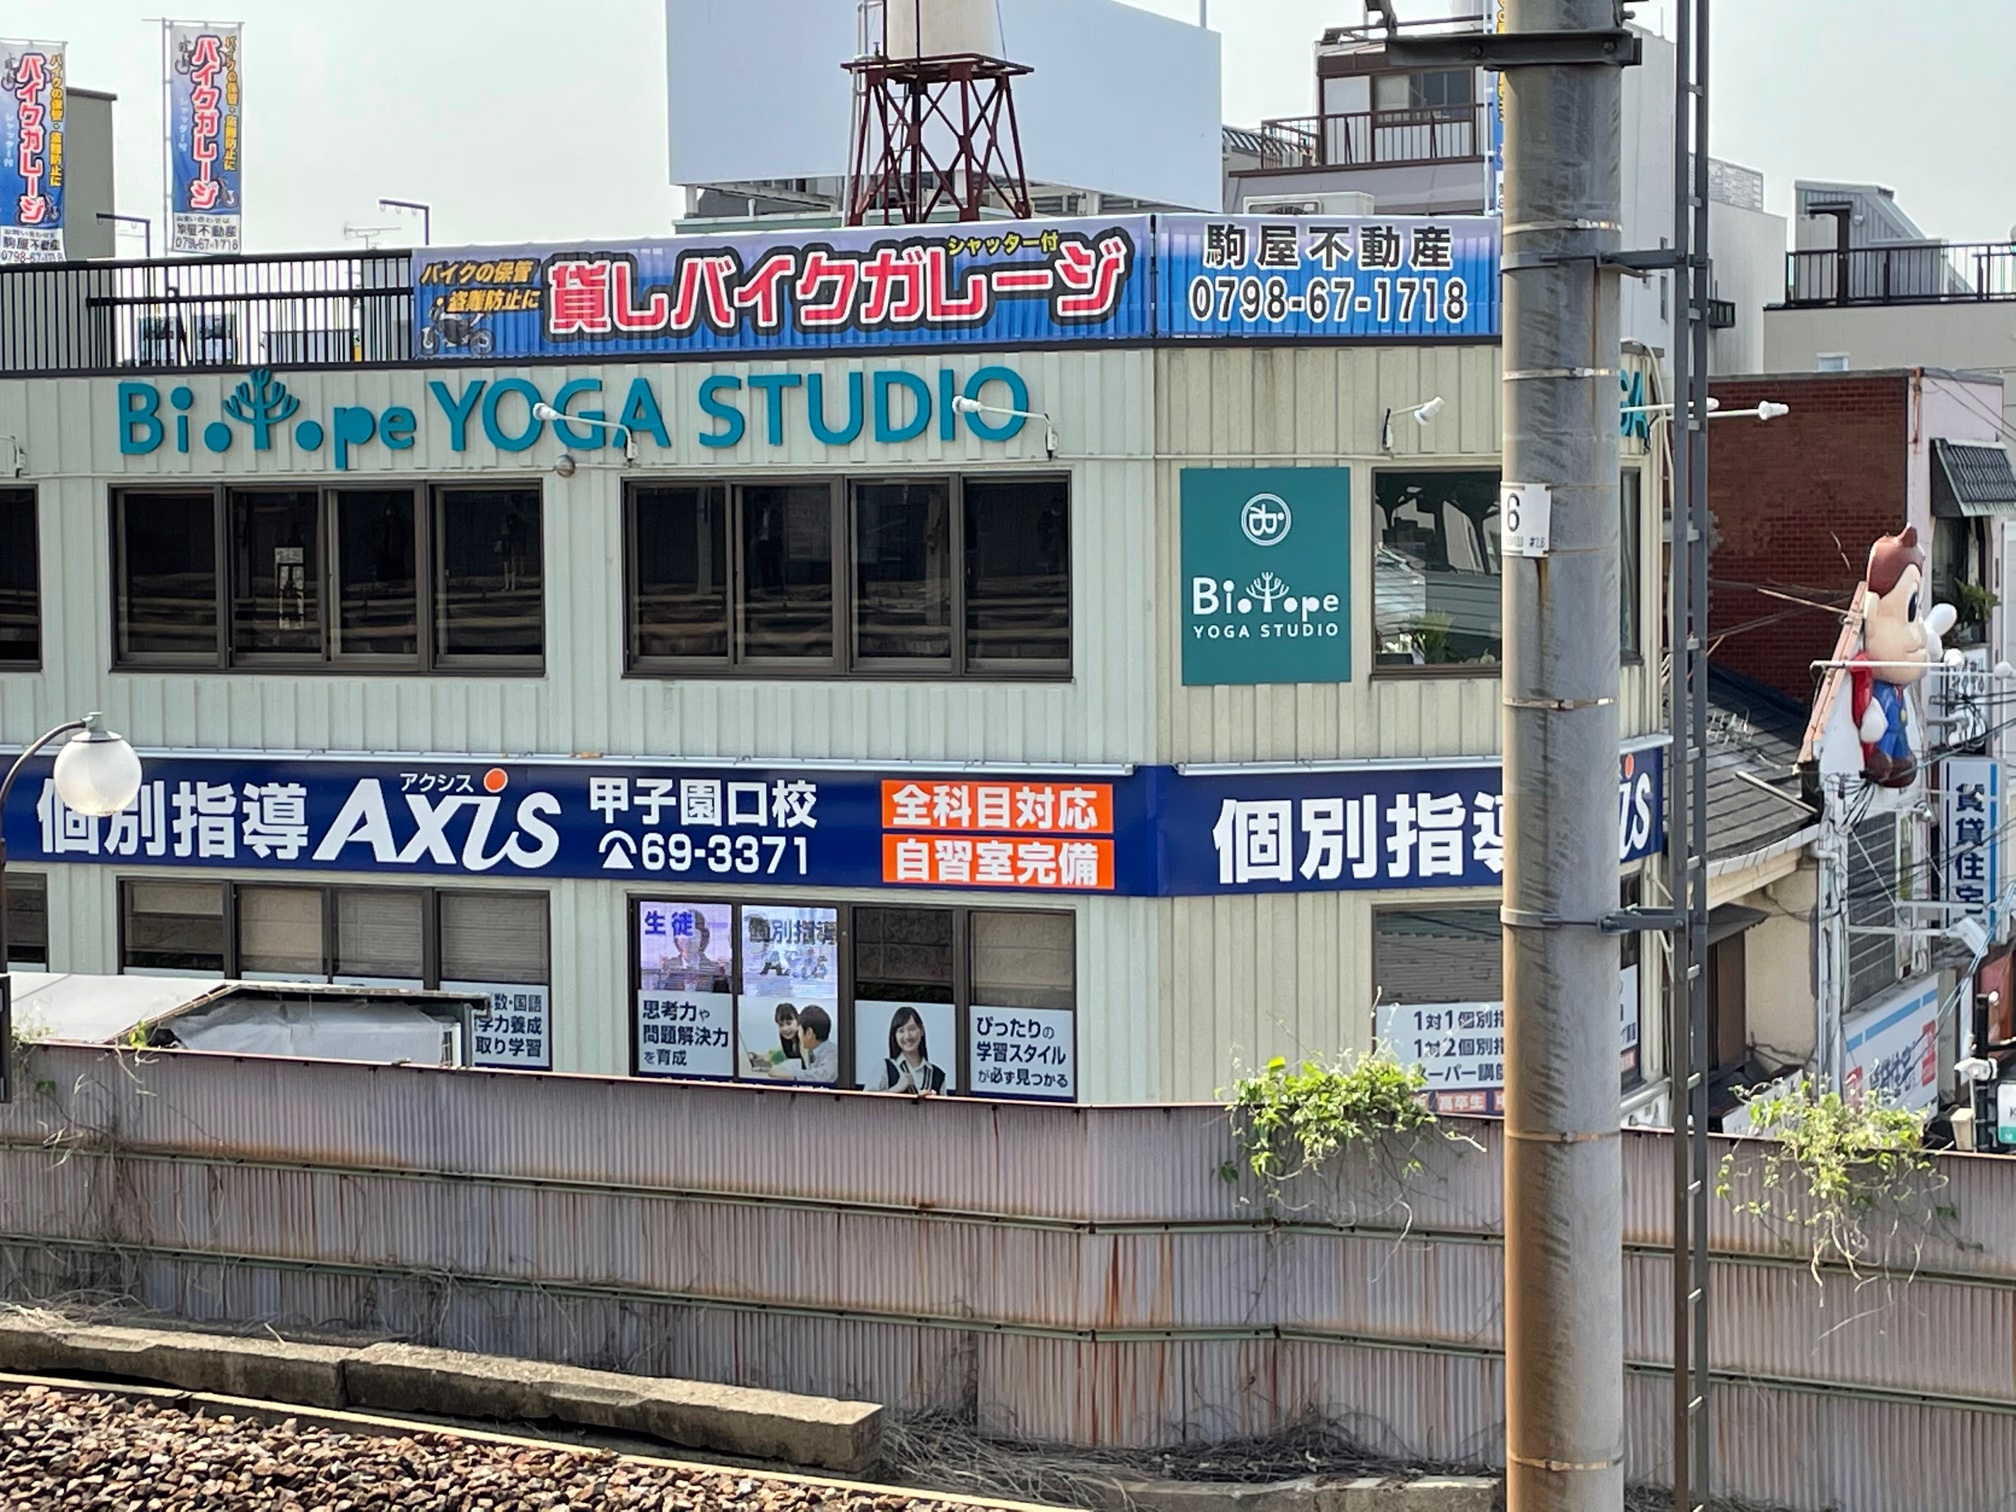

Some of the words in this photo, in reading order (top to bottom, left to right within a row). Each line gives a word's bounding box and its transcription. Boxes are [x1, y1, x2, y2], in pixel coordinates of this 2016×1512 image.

[190, 36, 221, 208] バイクガレージ
[17, 53, 46, 224] バイクガレージ
[948, 230, 1060, 256] シャッター付
[1204, 223, 1453, 271] 駒屋不動産
[421, 260, 534, 284] バイクの保管
[548, 236, 1129, 334] 貸しバイクガレージ
[1189, 276, 1468, 324] 0798-67-1718
[425, 377, 671, 453] YOGA
[699, 366, 1028, 447] STUDIO
[1193, 624, 1250, 639] YOGA
[1260, 622, 1339, 638] STUDIO
[401, 771, 475, 793] アクシス
[589, 777, 817, 829] 甲子園口校
[892, 785, 1099, 830] 全科目対応
[36, 778, 309, 861] 個別指導
[641, 833, 807, 875] 69-3371
[896, 838, 1099, 887] 自習室完備
[642, 1000, 710, 1021] 思考力や
[474, 1014, 542, 1035] 学力養成
[642, 1024, 729, 1048] 問題解決力
[977, 1016, 1054, 1039] ぴったりの
[475, 1036, 542, 1057] 取り学習
[644, 1049, 687, 1066] を育成
[977, 1041, 1066, 1065] 学習スタイル
[978, 1066, 1068, 1088] が必ず見つかる
